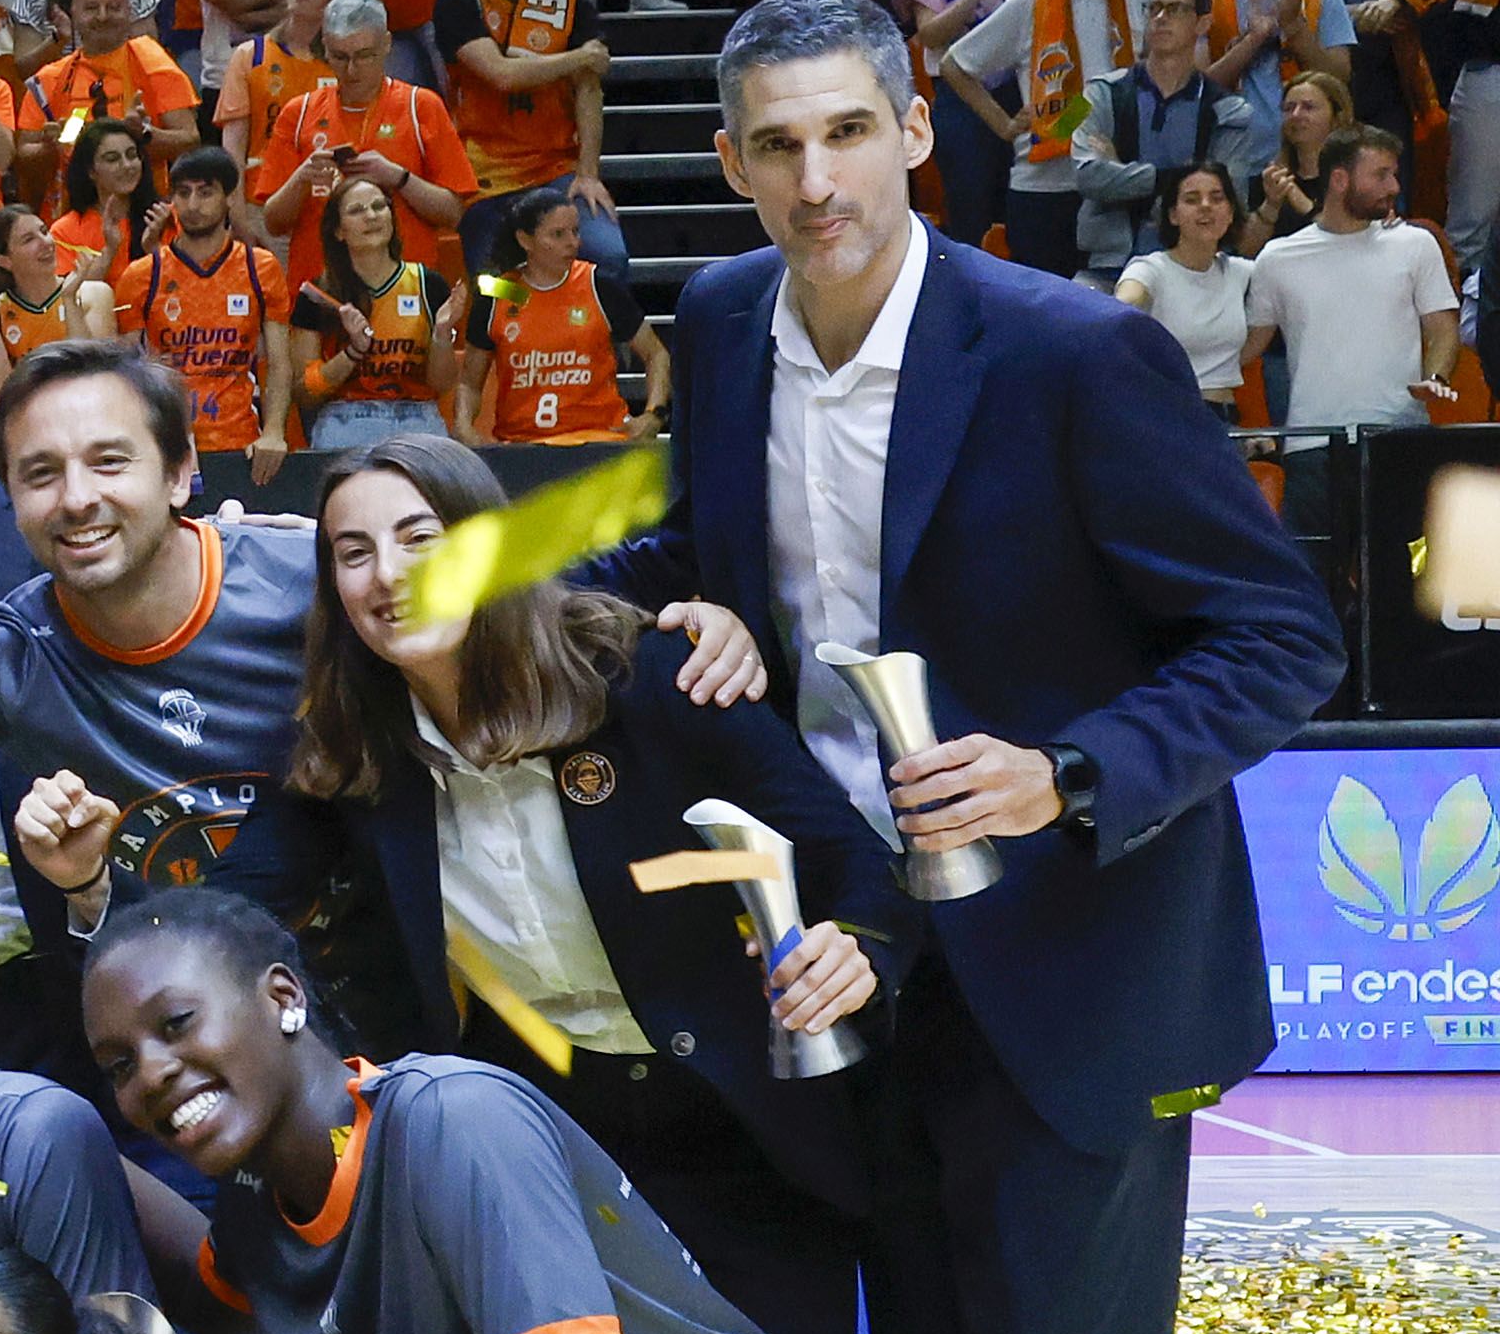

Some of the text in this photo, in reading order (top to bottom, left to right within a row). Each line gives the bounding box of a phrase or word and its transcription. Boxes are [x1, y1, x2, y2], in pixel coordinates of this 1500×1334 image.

[510, 349, 576, 370] Cultura
[535, 393, 559, 428] 8
[113, 782, 258, 874] CAMPIO
[1269, 964, 1343, 1005] LF
[1277, 1020, 1412, 1042] PLAYOFF
